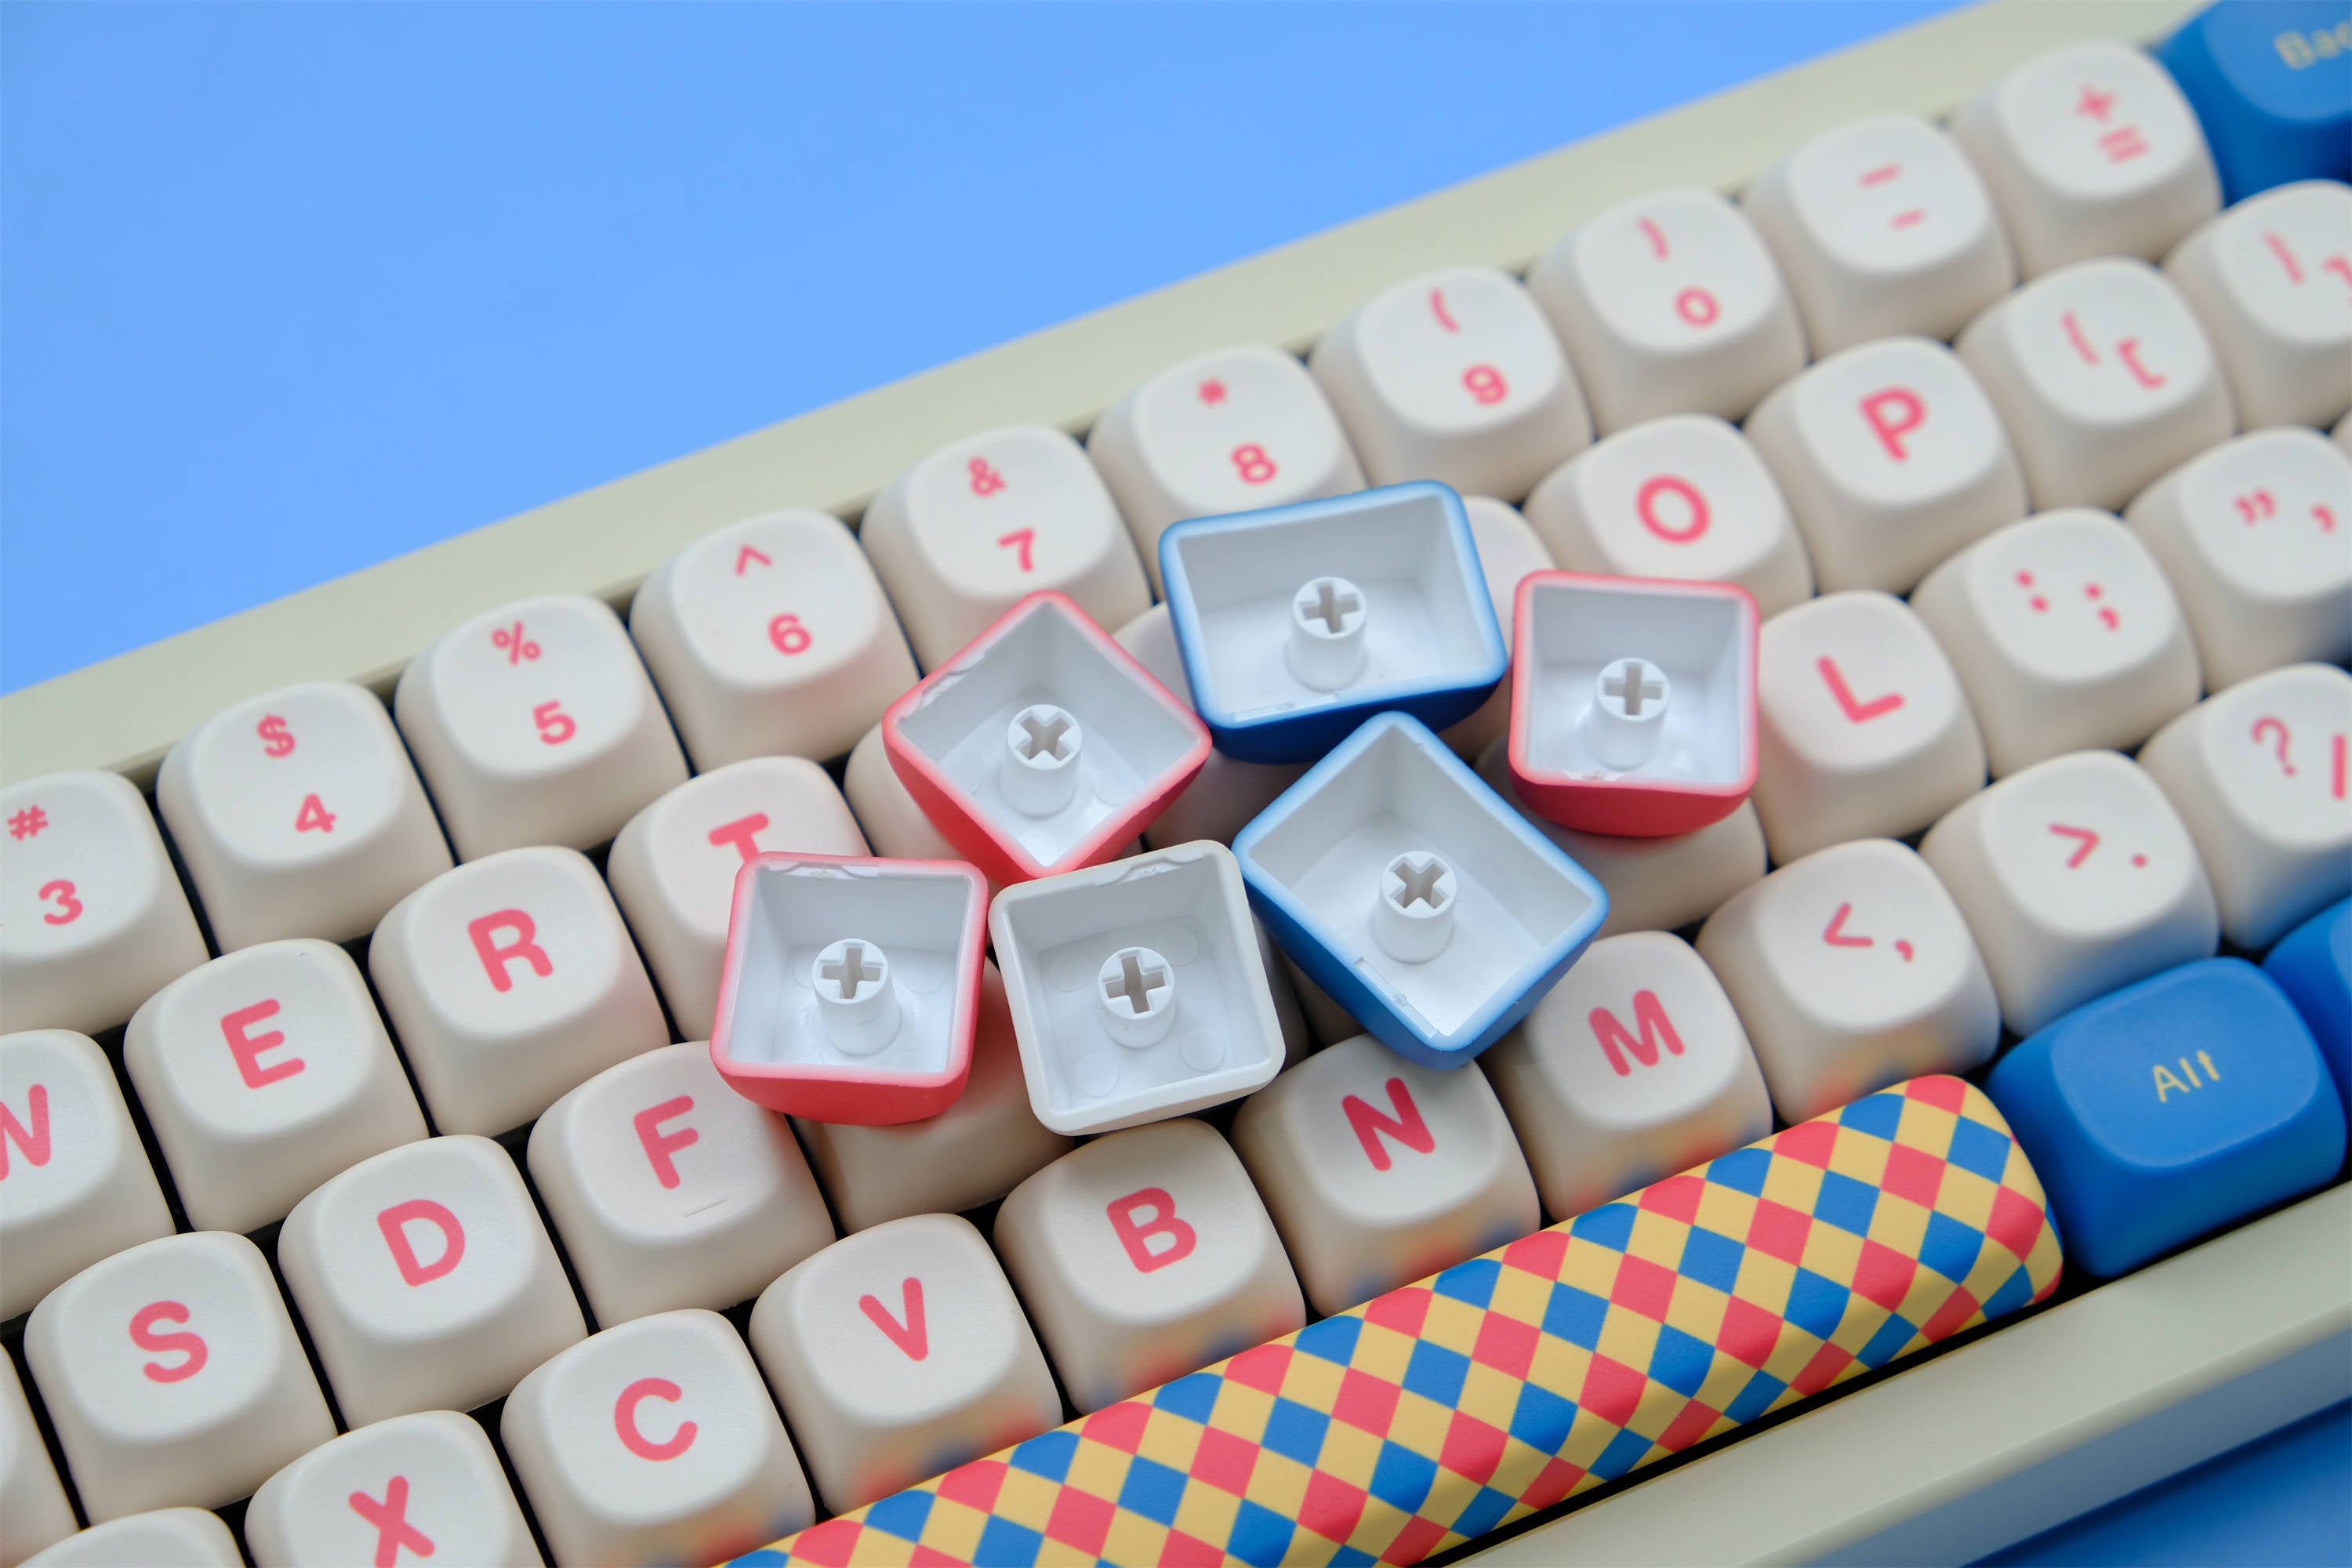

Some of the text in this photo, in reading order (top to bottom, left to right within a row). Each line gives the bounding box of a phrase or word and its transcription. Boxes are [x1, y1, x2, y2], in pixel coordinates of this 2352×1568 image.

[1460, 364, 1508, 406] 9
[1858, 386, 1927, 463] P
[1230, 442, 1279, 486] 8
[1635, 474, 1712, 546] O
[997, 526, 1036, 573] 7
[492, 622, 543, 666] %
[767, 612, 813, 656] 6
[533, 699, 577, 746] 5
[1814, 655, 1907, 725] L
[256, 713, 297, 758] $
[7, 804, 49, 841] #
[294, 793, 337, 833] 4
[38, 878, 84, 927] 3
[468, 908, 554, 993] R
[220, 998, 307, 1090] E
[1588, 988, 1686, 1078] M
[2151, 1049, 2221, 1104] Alt
[632, 1094, 700, 1191] F
[1341, 1076, 1436, 1173] N
[377, 1199, 466, 1287] D
[1105, 1185, 1198, 1274] B
[129, 1300, 209, 1384] S
[858, 1276, 930, 1363] V
[614, 1377, 699, 1461] C
[348, 1474, 436, 1568] X
